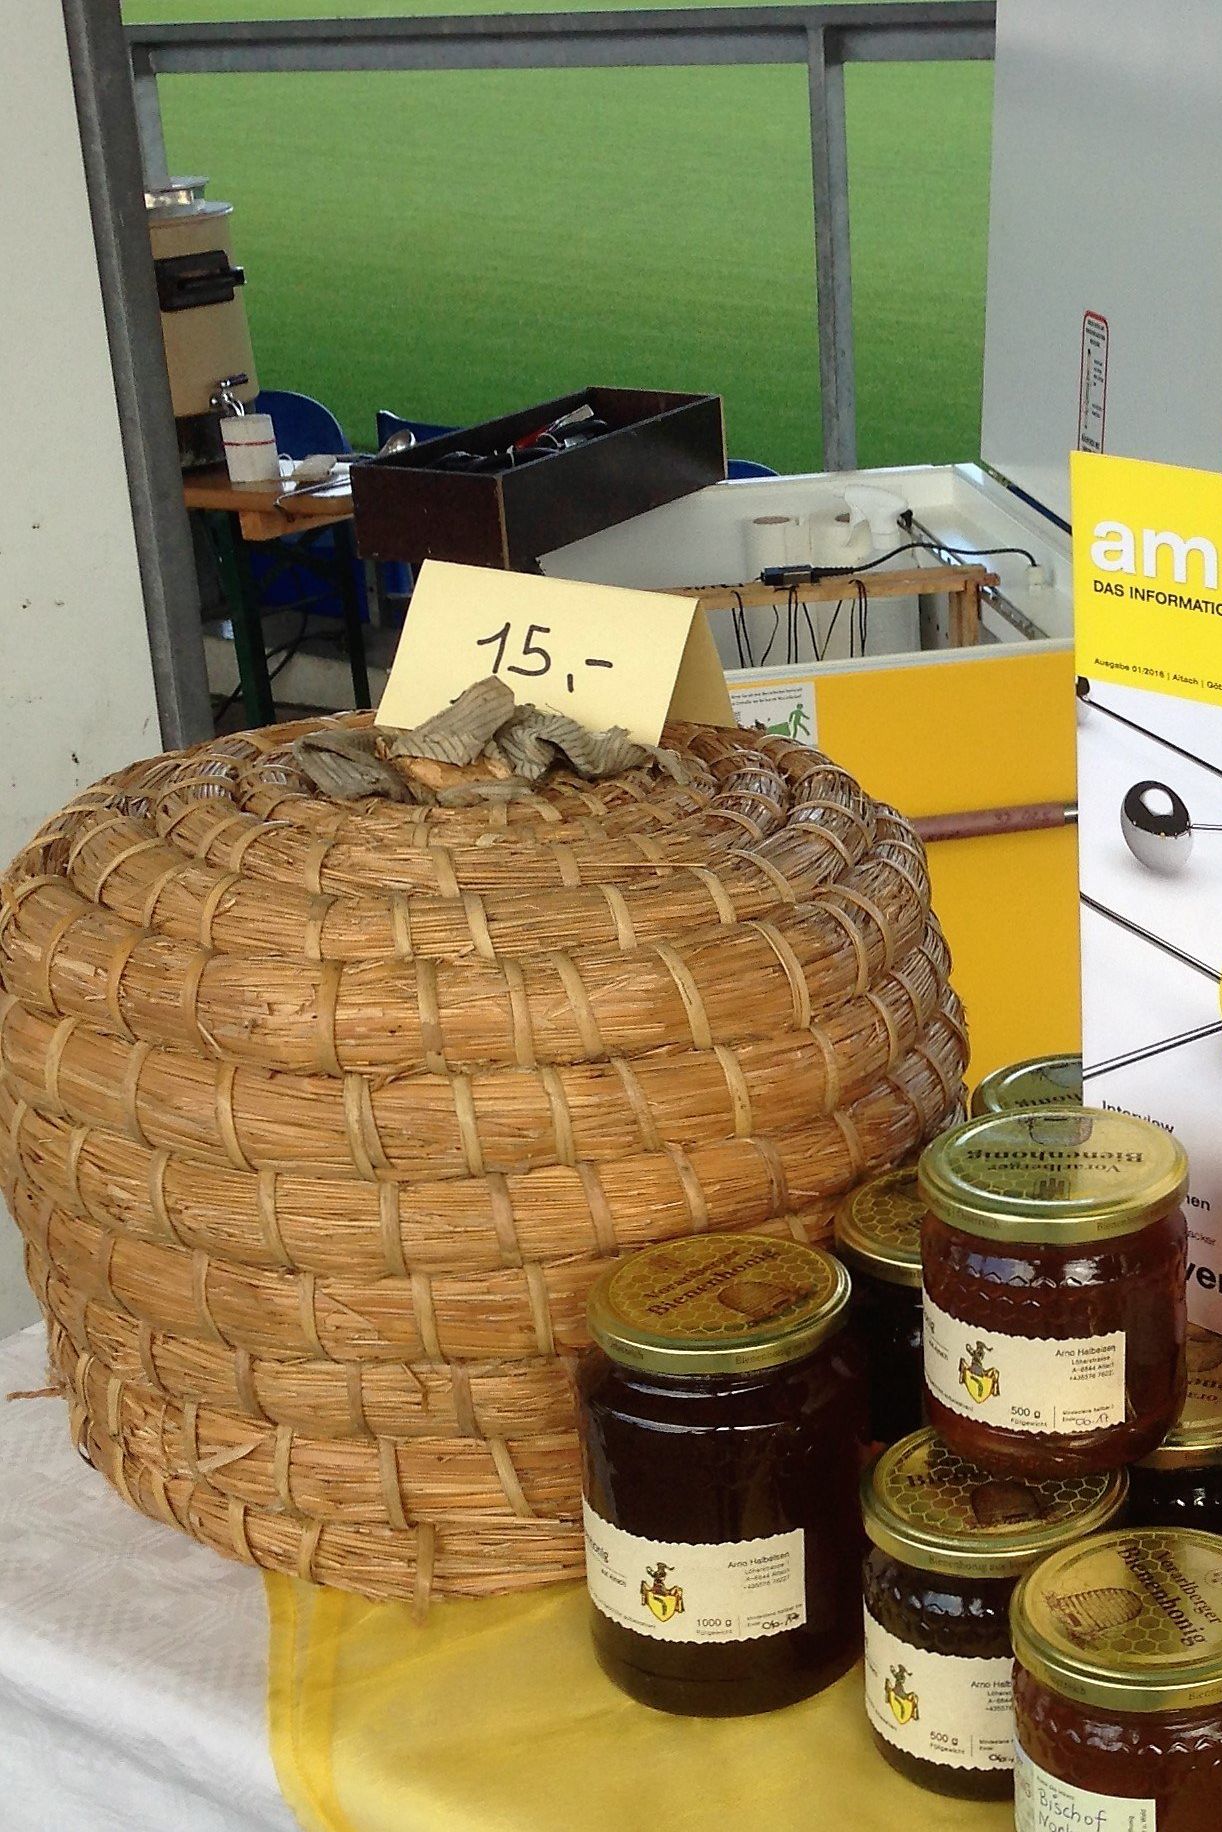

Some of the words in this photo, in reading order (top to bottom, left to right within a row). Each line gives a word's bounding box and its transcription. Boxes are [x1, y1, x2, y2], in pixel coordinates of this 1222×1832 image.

[1093, 579, 1125, 598] DAS
[1094, 658, 1130, 672] Ausgabe
[1055, 1348, 1075, 1357] Arno
[1011, 1406, 1031, 1417] 500
[1034, 1410, 1041, 1419] g
[727, 1559, 748, 1569] Arno
[1157, 1549, 1222, 1625] Vorarlberger
[1118, 1545, 1206, 1648] Bienenhonig
[697, 1618, 723, 1628] 1000
[725, 1619, 732, 1629] g
[970, 1680, 990, 1688] Arno
[930, 1730, 949, 1743] 500
[1037, 1788, 1107, 1832] Bischof
